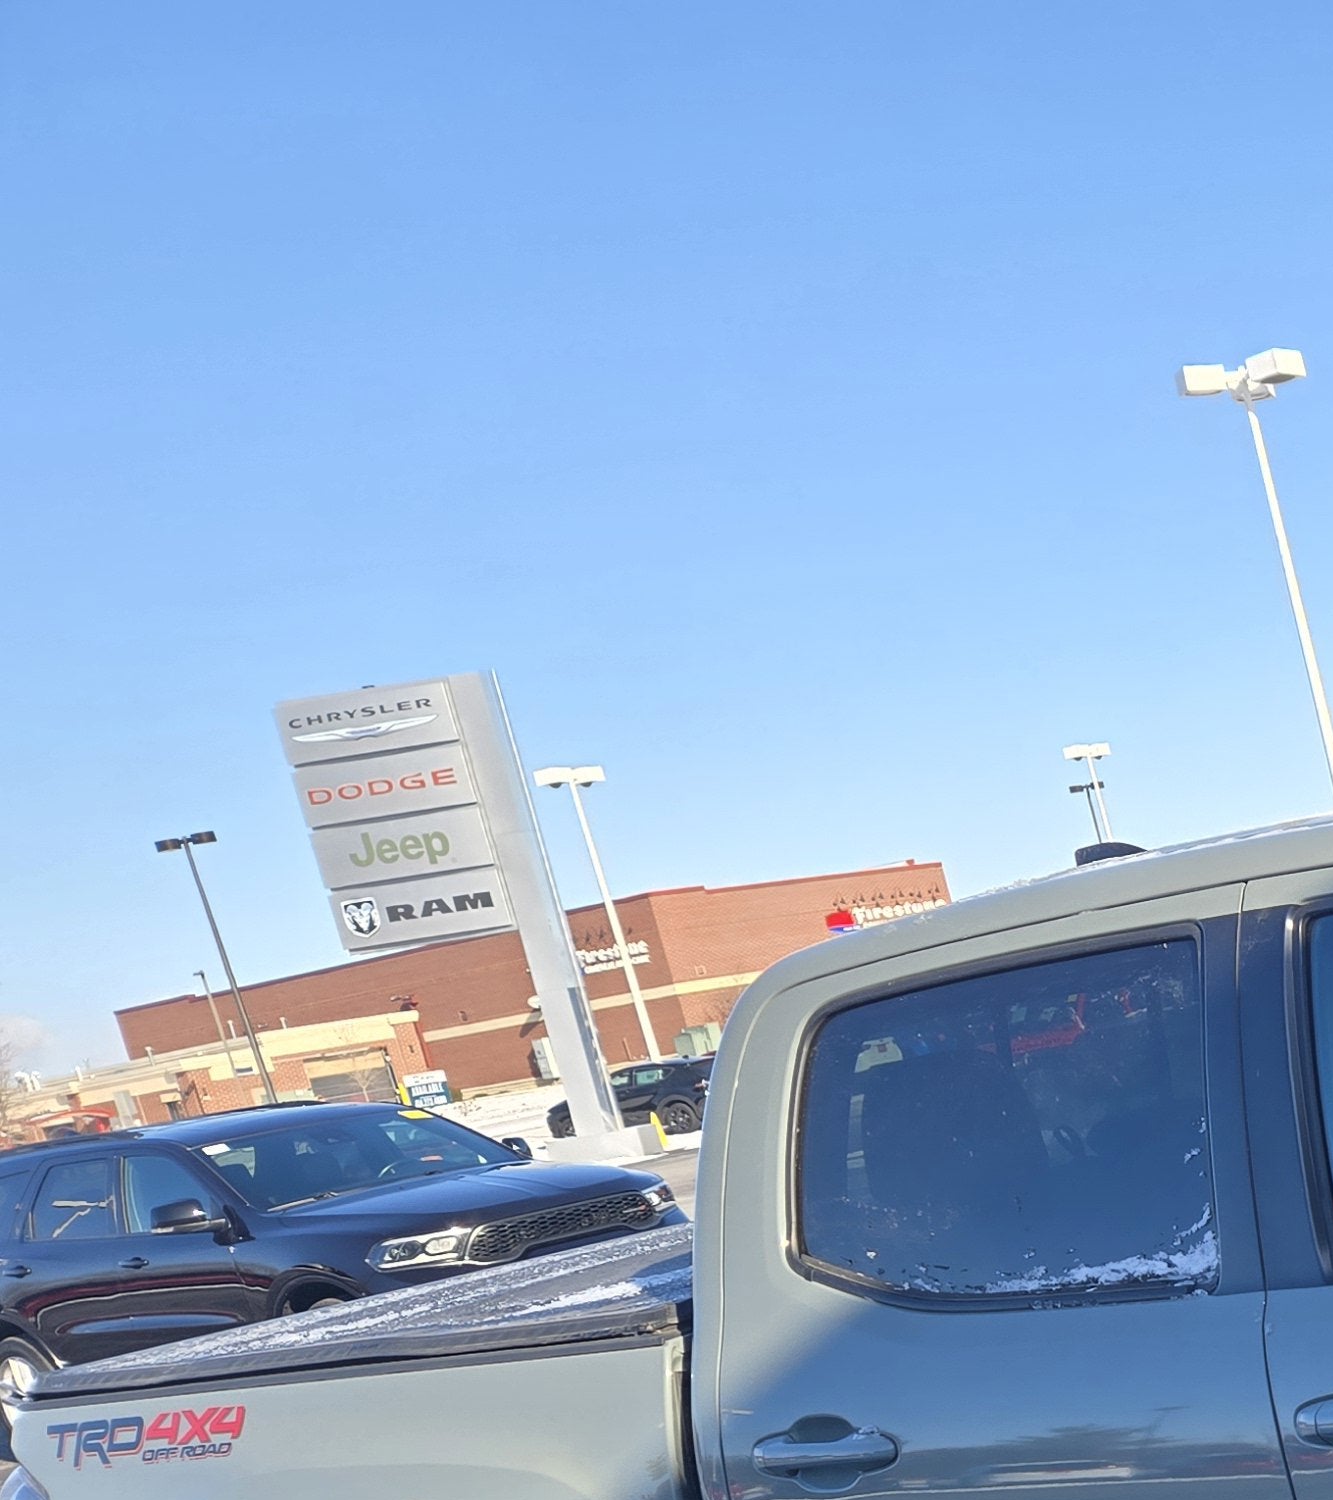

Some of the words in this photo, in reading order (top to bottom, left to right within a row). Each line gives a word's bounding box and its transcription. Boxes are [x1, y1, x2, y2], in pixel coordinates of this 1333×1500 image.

[288, 697, 432, 729] CHRYSLER
[306, 767, 458, 806] DODGE
[350, 830, 450, 868] Jeep
[385, 890, 495, 923] RAM
[574, 939, 650, 969] Firestne
[46, 1415, 145, 1470] TRD
[142, 1446, 178, 1465] OFF
[178, 1441, 232, 1461] ROAD
